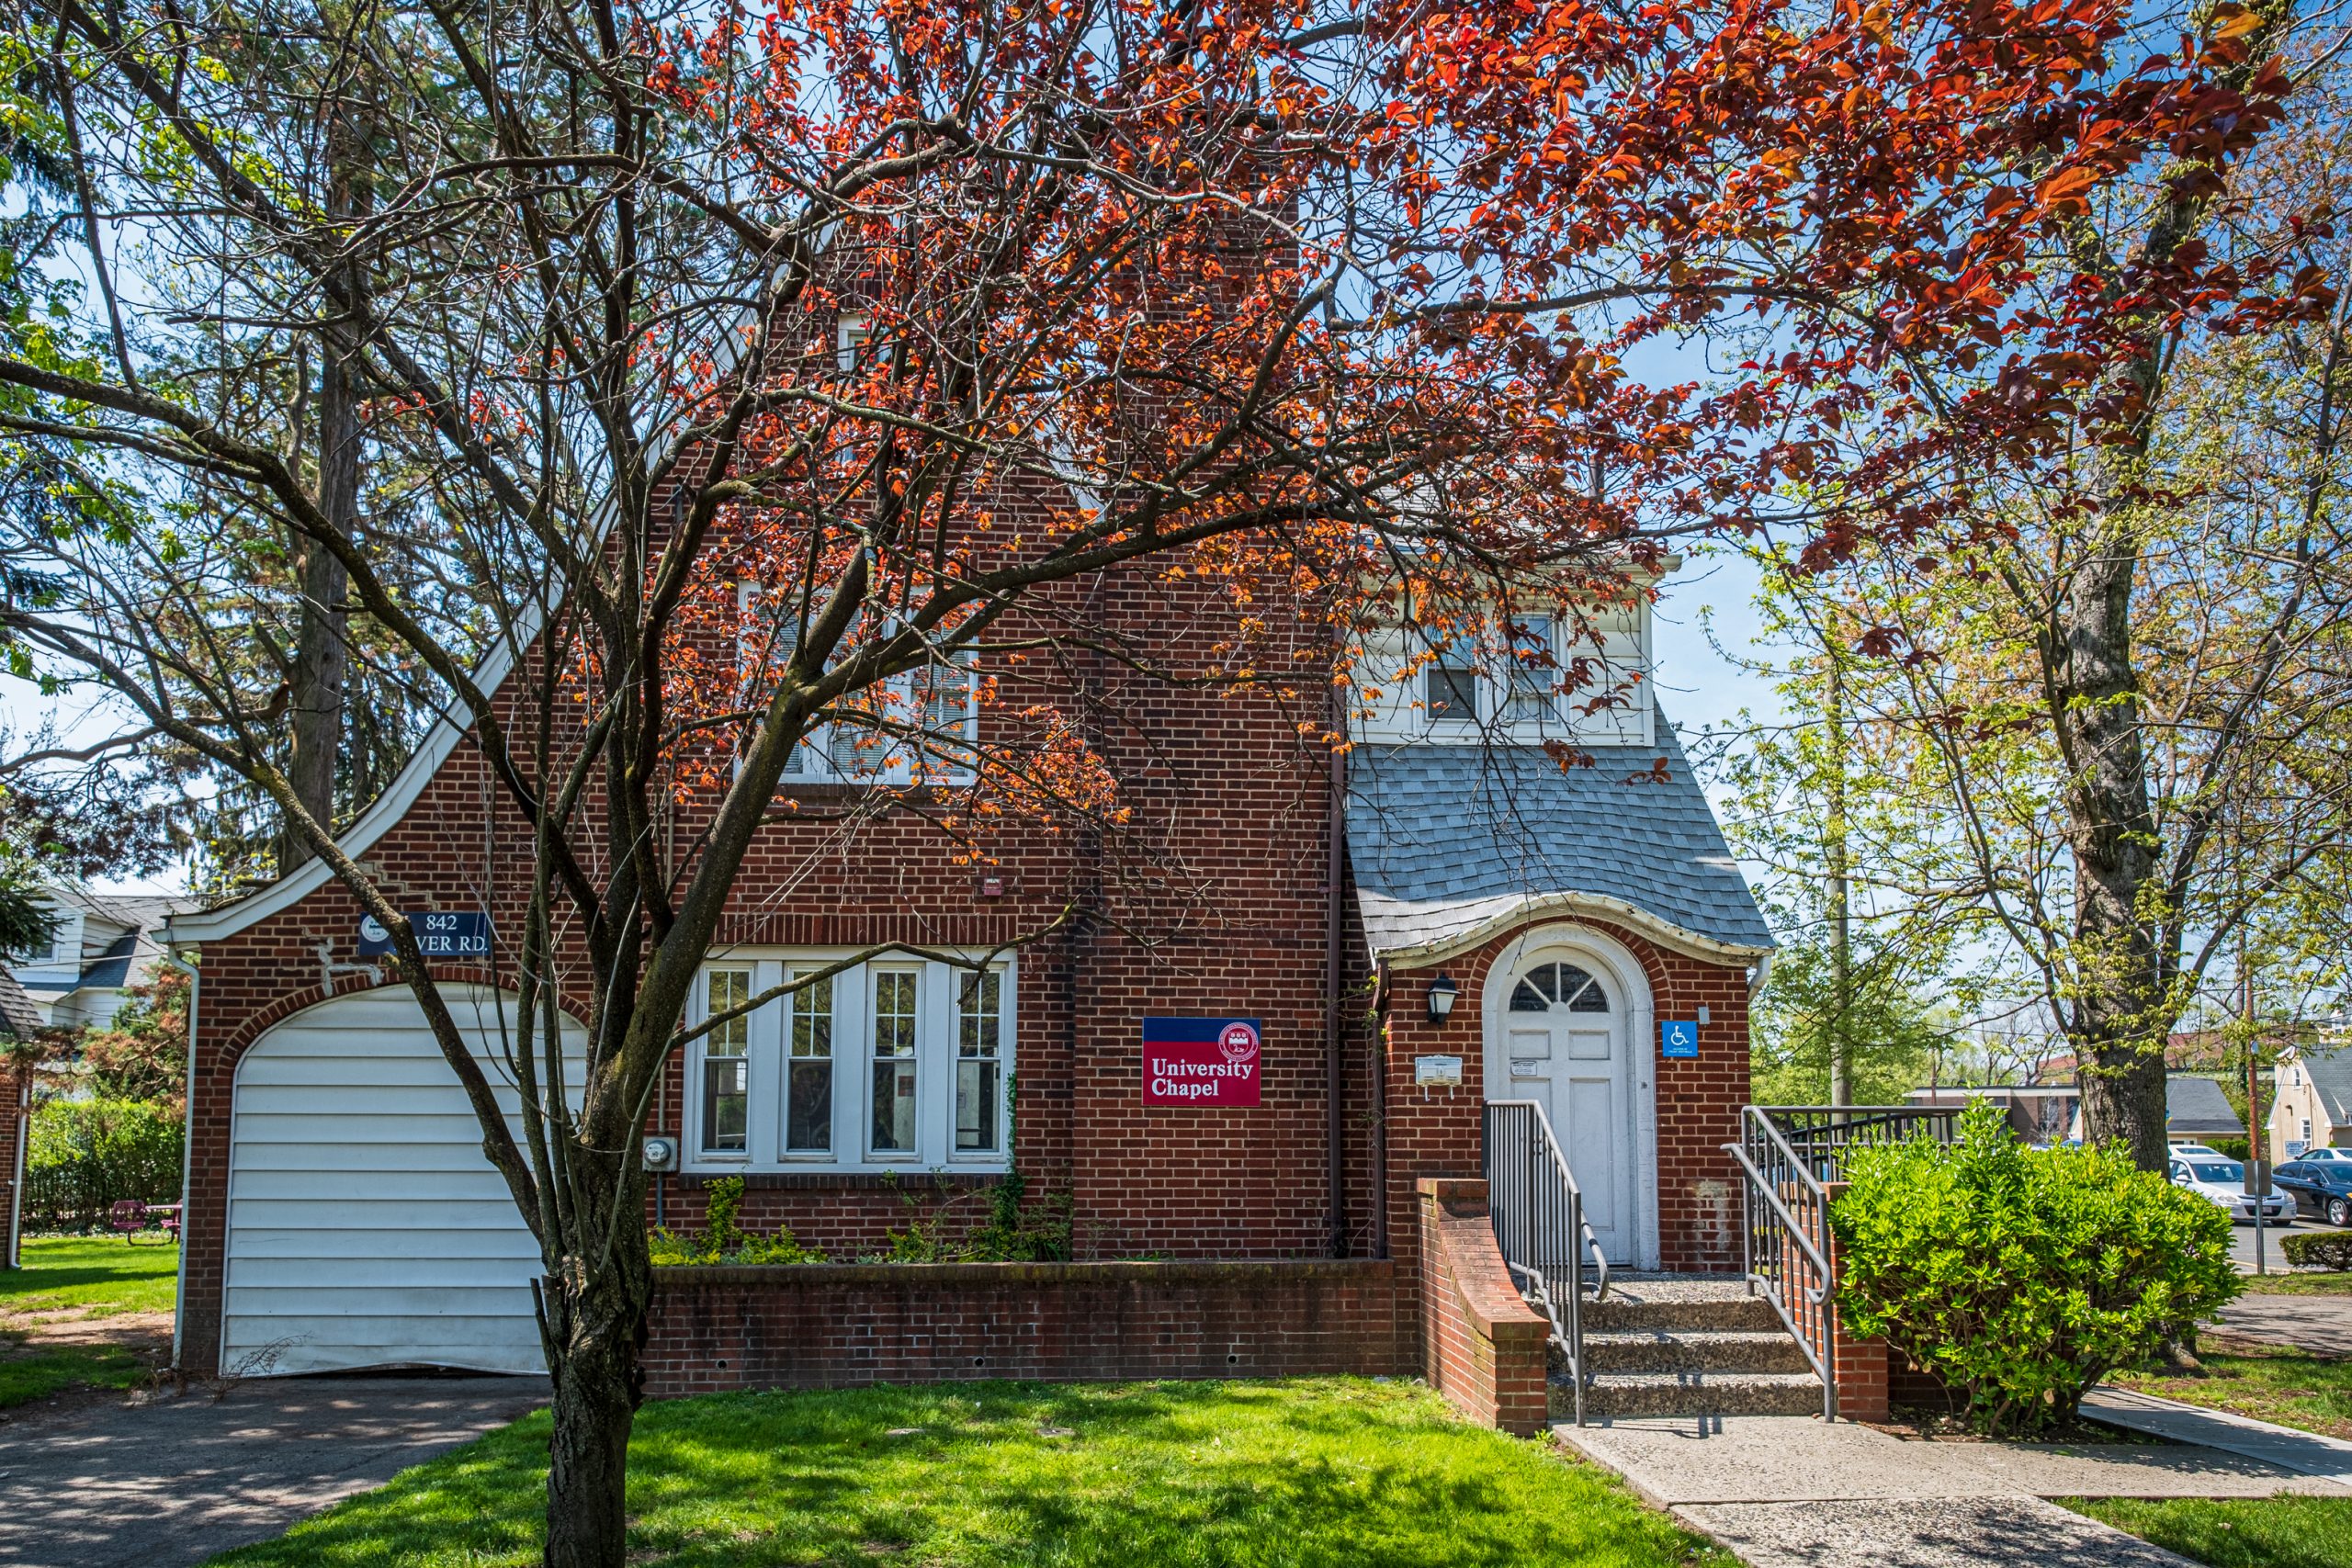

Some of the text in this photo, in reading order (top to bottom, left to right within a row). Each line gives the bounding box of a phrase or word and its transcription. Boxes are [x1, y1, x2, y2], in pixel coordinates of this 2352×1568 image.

[426, 915, 458, 931] 842
[394, 936, 488, 951] VER RD.
[1151, 1058, 1253, 1079] University
[1151, 1078, 1219, 1100] Chapel
